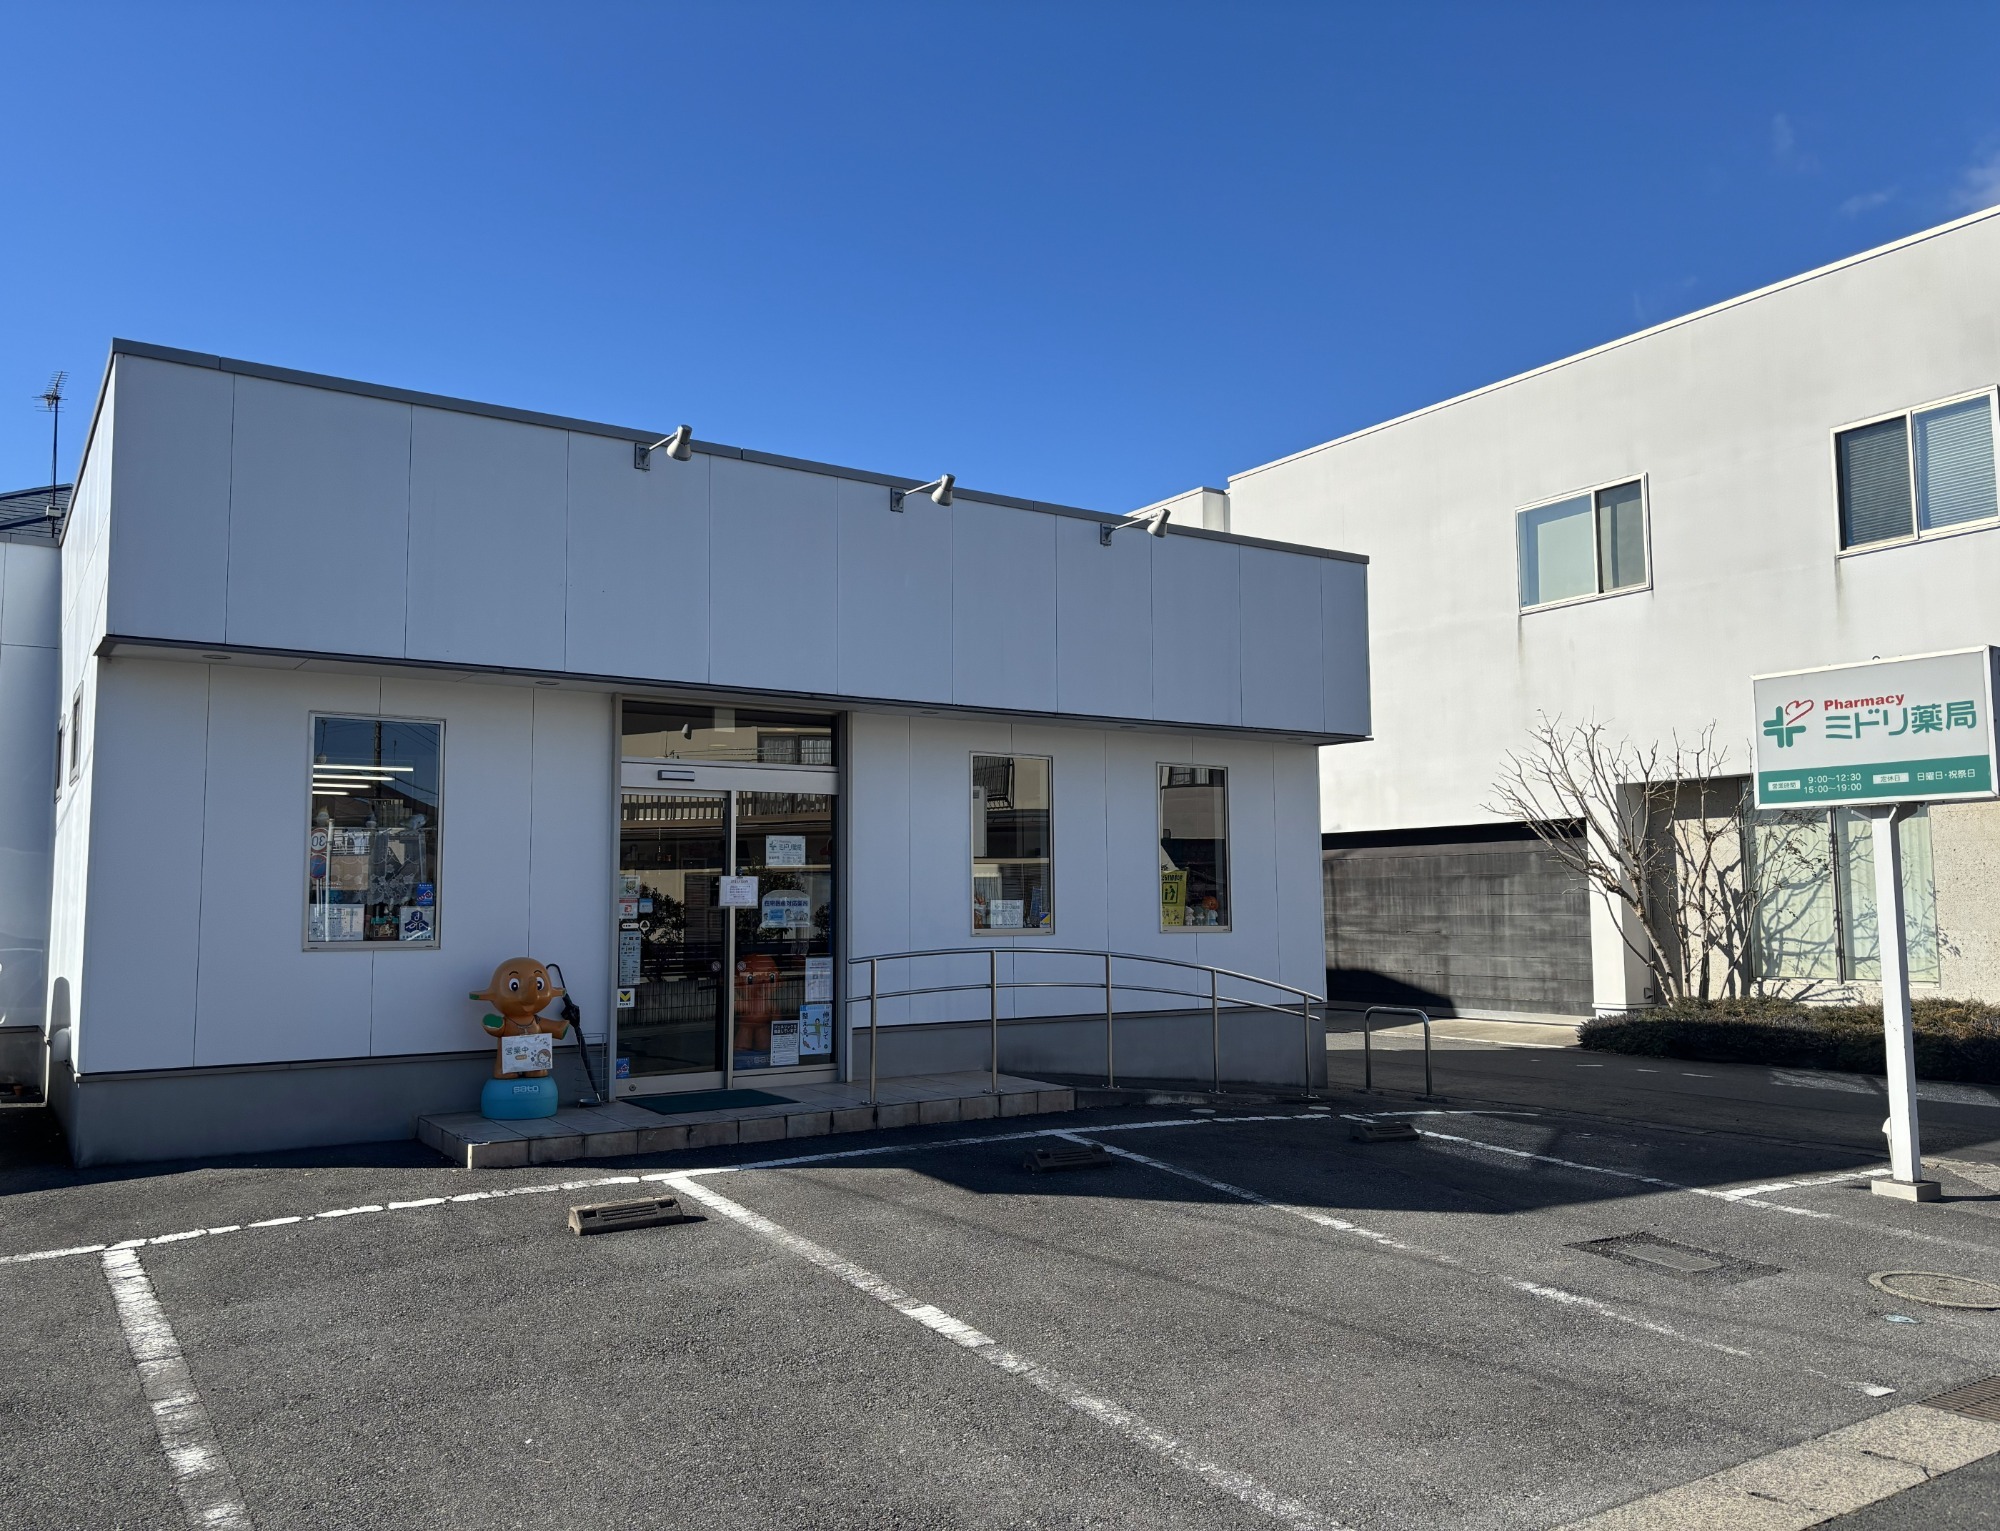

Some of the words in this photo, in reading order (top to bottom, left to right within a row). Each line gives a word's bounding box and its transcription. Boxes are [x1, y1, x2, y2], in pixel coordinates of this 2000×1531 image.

[1824, 693, 1904, 711] Pharmacy
[1825, 700, 1977, 739] ミドリ薬局
[1880, 775, 1901, 783] 定休日
[1771, 782, 1797, 790] 営業時間
[513, 1085, 539, 1093] sato
